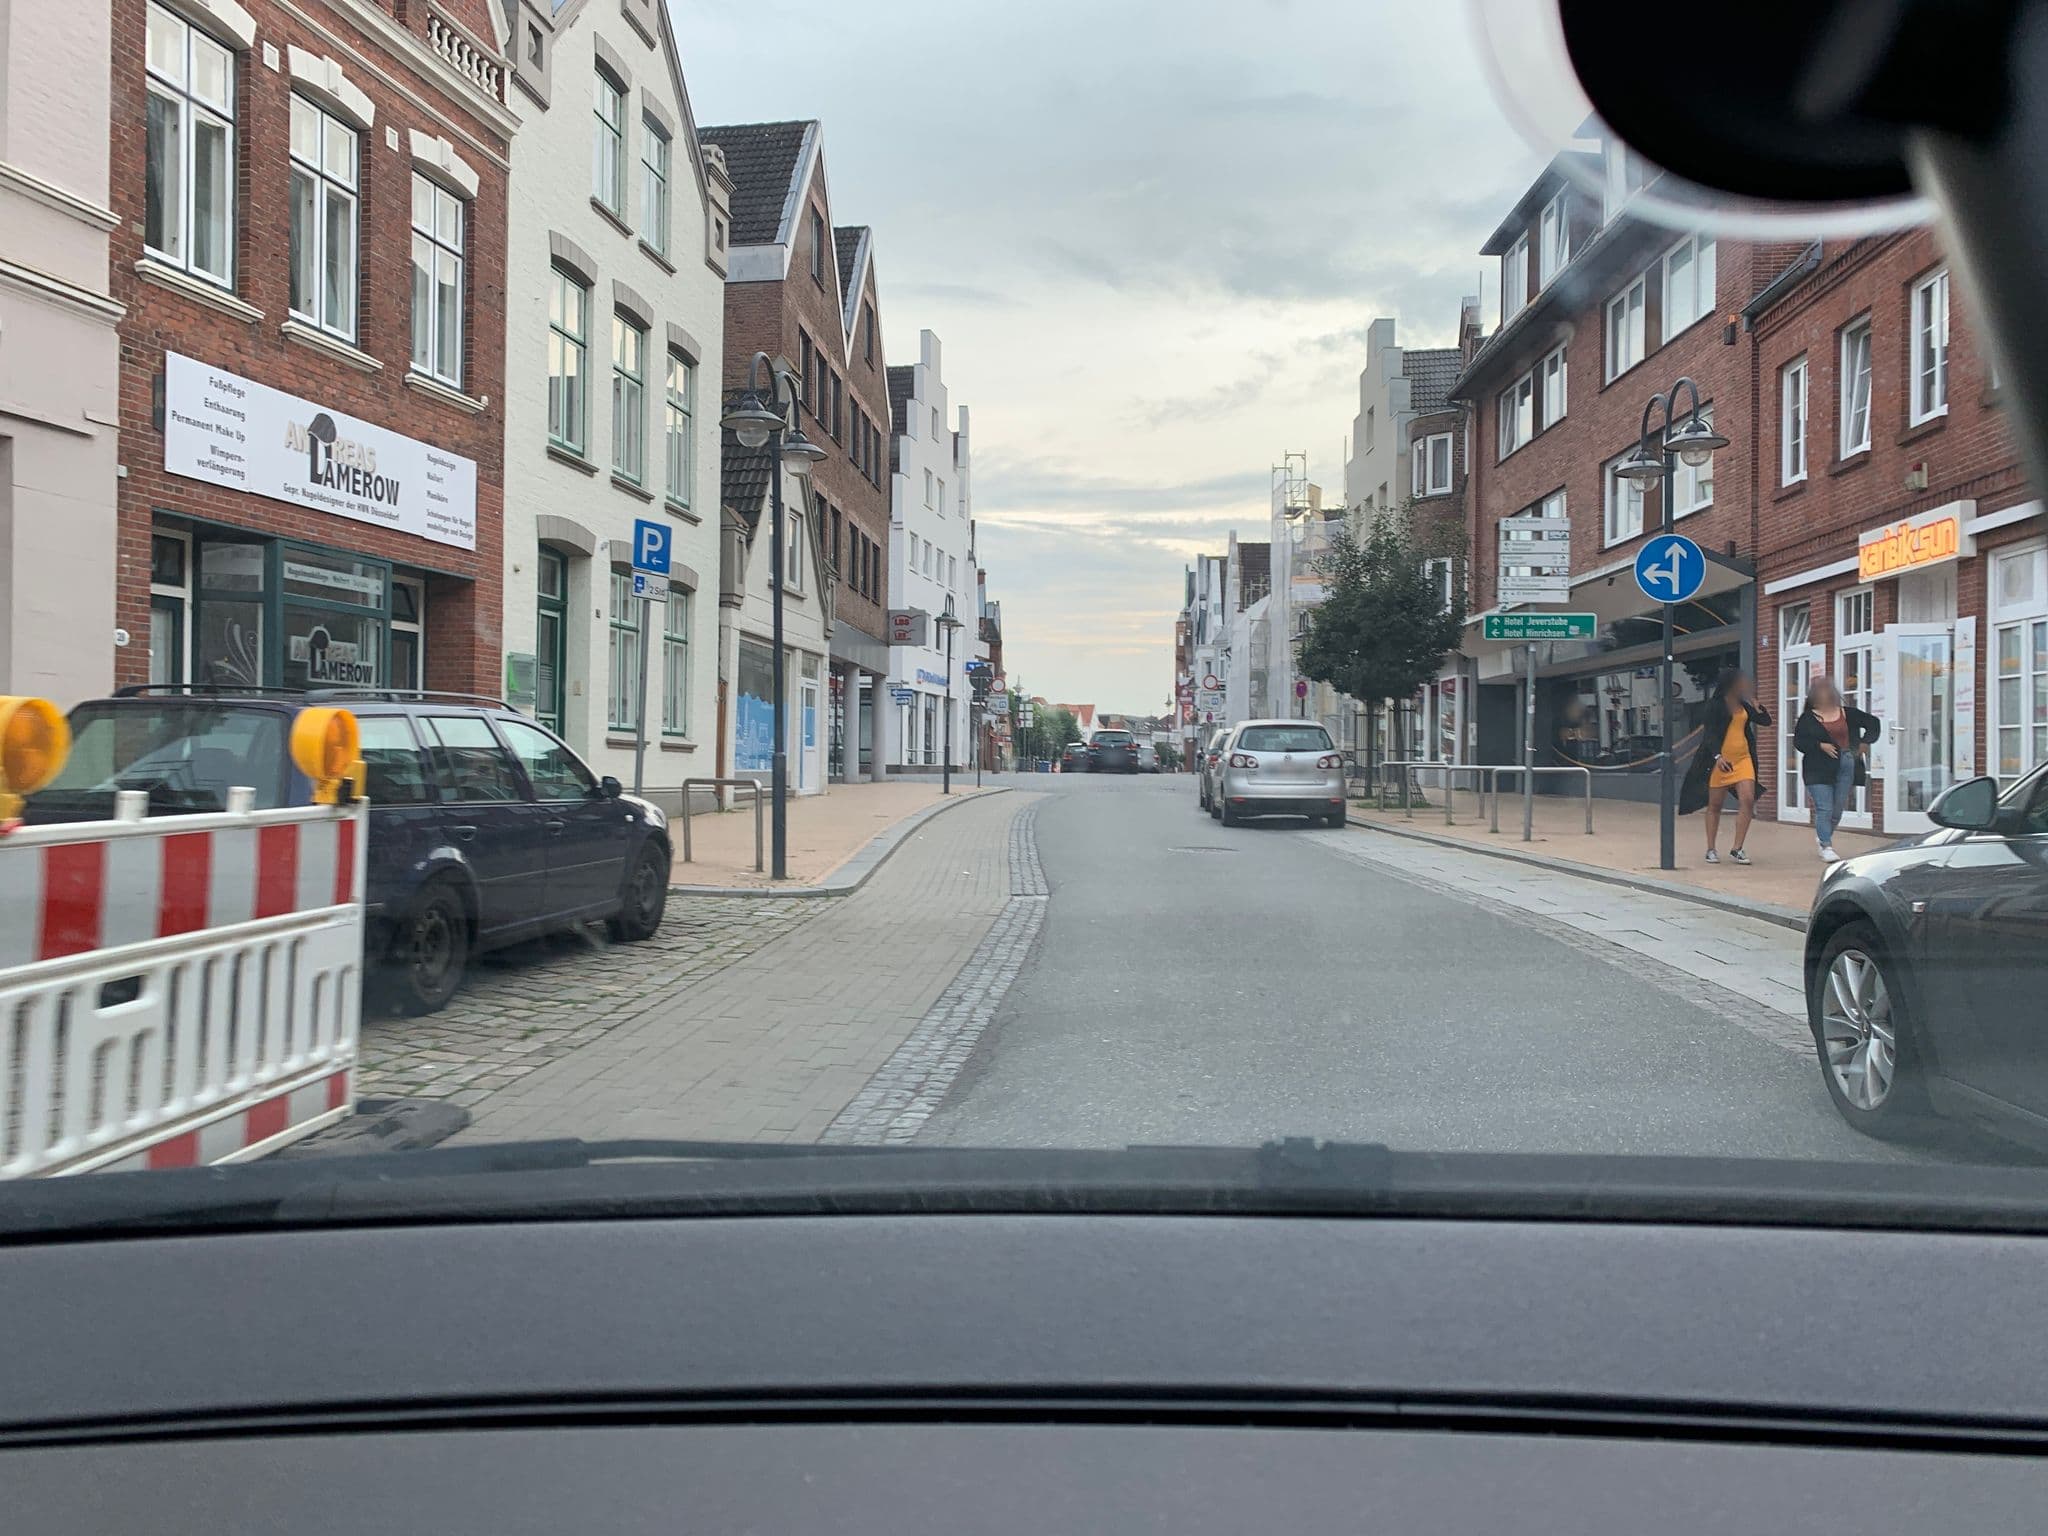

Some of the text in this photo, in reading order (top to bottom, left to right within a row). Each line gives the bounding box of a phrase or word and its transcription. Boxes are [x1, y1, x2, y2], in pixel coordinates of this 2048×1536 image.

[204, 397, 246, 422] Enthaarung
[171, 409, 246, 443] Permanent Make Up
[196, 459, 246, 481] verlängerung
[310, 434, 400, 506] LAMEROW
[642, 527, 663, 563] P
[1503, 617, 1523, 626] Hotel
[1503, 629, 1523, 637] Hotel
[1526, 629, 1566, 637] Hinrichsen
[310, 646, 373, 684] LAMEROW
